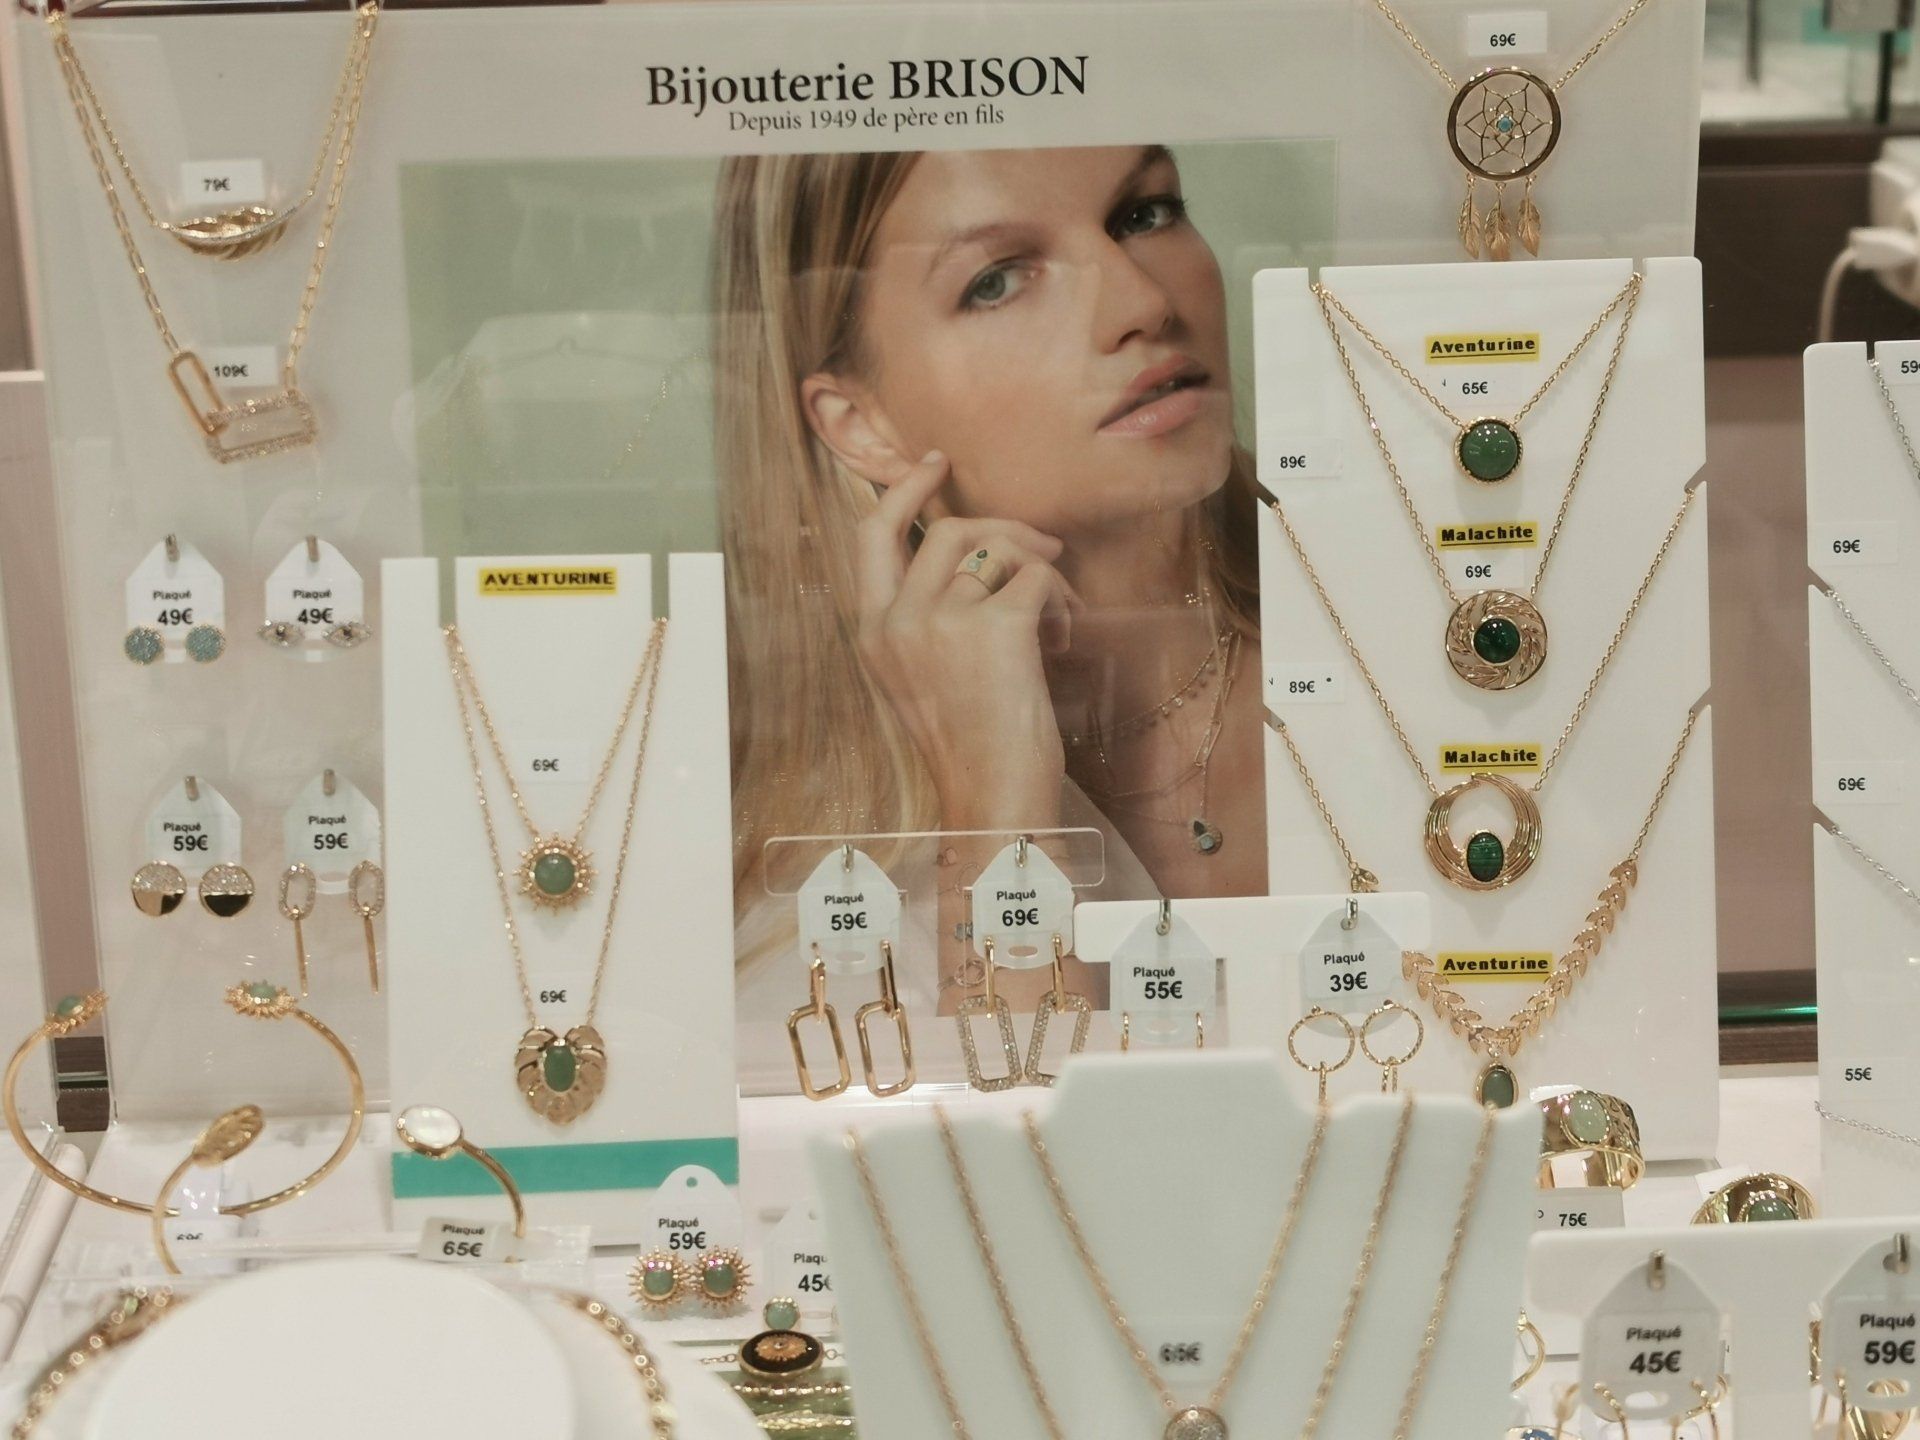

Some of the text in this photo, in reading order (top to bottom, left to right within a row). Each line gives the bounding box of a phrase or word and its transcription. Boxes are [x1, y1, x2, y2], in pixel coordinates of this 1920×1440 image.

[1489, 33, 1517, 47] 69€
[645, 55, 1089, 117] Bijouterie BRISON
[729, 103, 1005, 136] Depuis 1949 de père en fils
[203, 177, 231, 191] 79€
[1430, 338, 1536, 354] Aventurine
[214, 364, 249, 378] 109€
[1900, 360, 1920, 375] 59
[1461, 381, 1489, 395] 65€
[1279, 455, 1307, 469] 89€
[1441, 525, 1534, 542] Malachite
[1832, 540, 1861, 553] 69€
[484, 571, 615, 586] AVENTURINE
[1465, 564, 1492, 578] 69€
[153, 589, 192, 602] Plaqué
[293, 588, 332, 601] Plaqué
[157, 608, 194, 625] 49€
[297, 608, 334, 624] 49€
[1289, 680, 1316, 693] 89€
[1444, 750, 1538, 764] Malachite
[532, 758, 560, 772] 69€
[1837, 777, 1866, 791] 69€
[163, 821, 202, 834] Plaqué
[308, 814, 347, 827] Plaqué
[173, 834, 209, 851] 59€
[313, 833, 349, 850] 59€
[824, 894, 864, 906] Plaqué
[996, 889, 1036, 903] Plaqué
[830, 912, 868, 931] 59€
[1002, 908, 1039, 927] 69€
[1323, 951, 1365, 967] Plaqué
[1443, 956, 1549, 971] Aventurine
[1133, 966, 1176, 980] Plaqué
[1329, 971, 1369, 993] 39€
[540, 989, 567, 1003] 69€
[1144, 980, 1183, 1000] 55€
[1844, 1067, 1872, 1081] 55€
[658, 1217, 700, 1230] Plaqué
[1558, 1212, 1588, 1227] 75€
[669, 1231, 706, 1250] 59€
[443, 1240, 483, 1258] 65€
[793, 1252, 829, 1266] Plaqu
[1859, 1313, 1916, 1331] Plaqué
[1626, 1324, 1682, 1342] Plaqué
[1864, 1339, 1916, 1364] 59€
[1629, 1350, 1682, 1375] 45€
